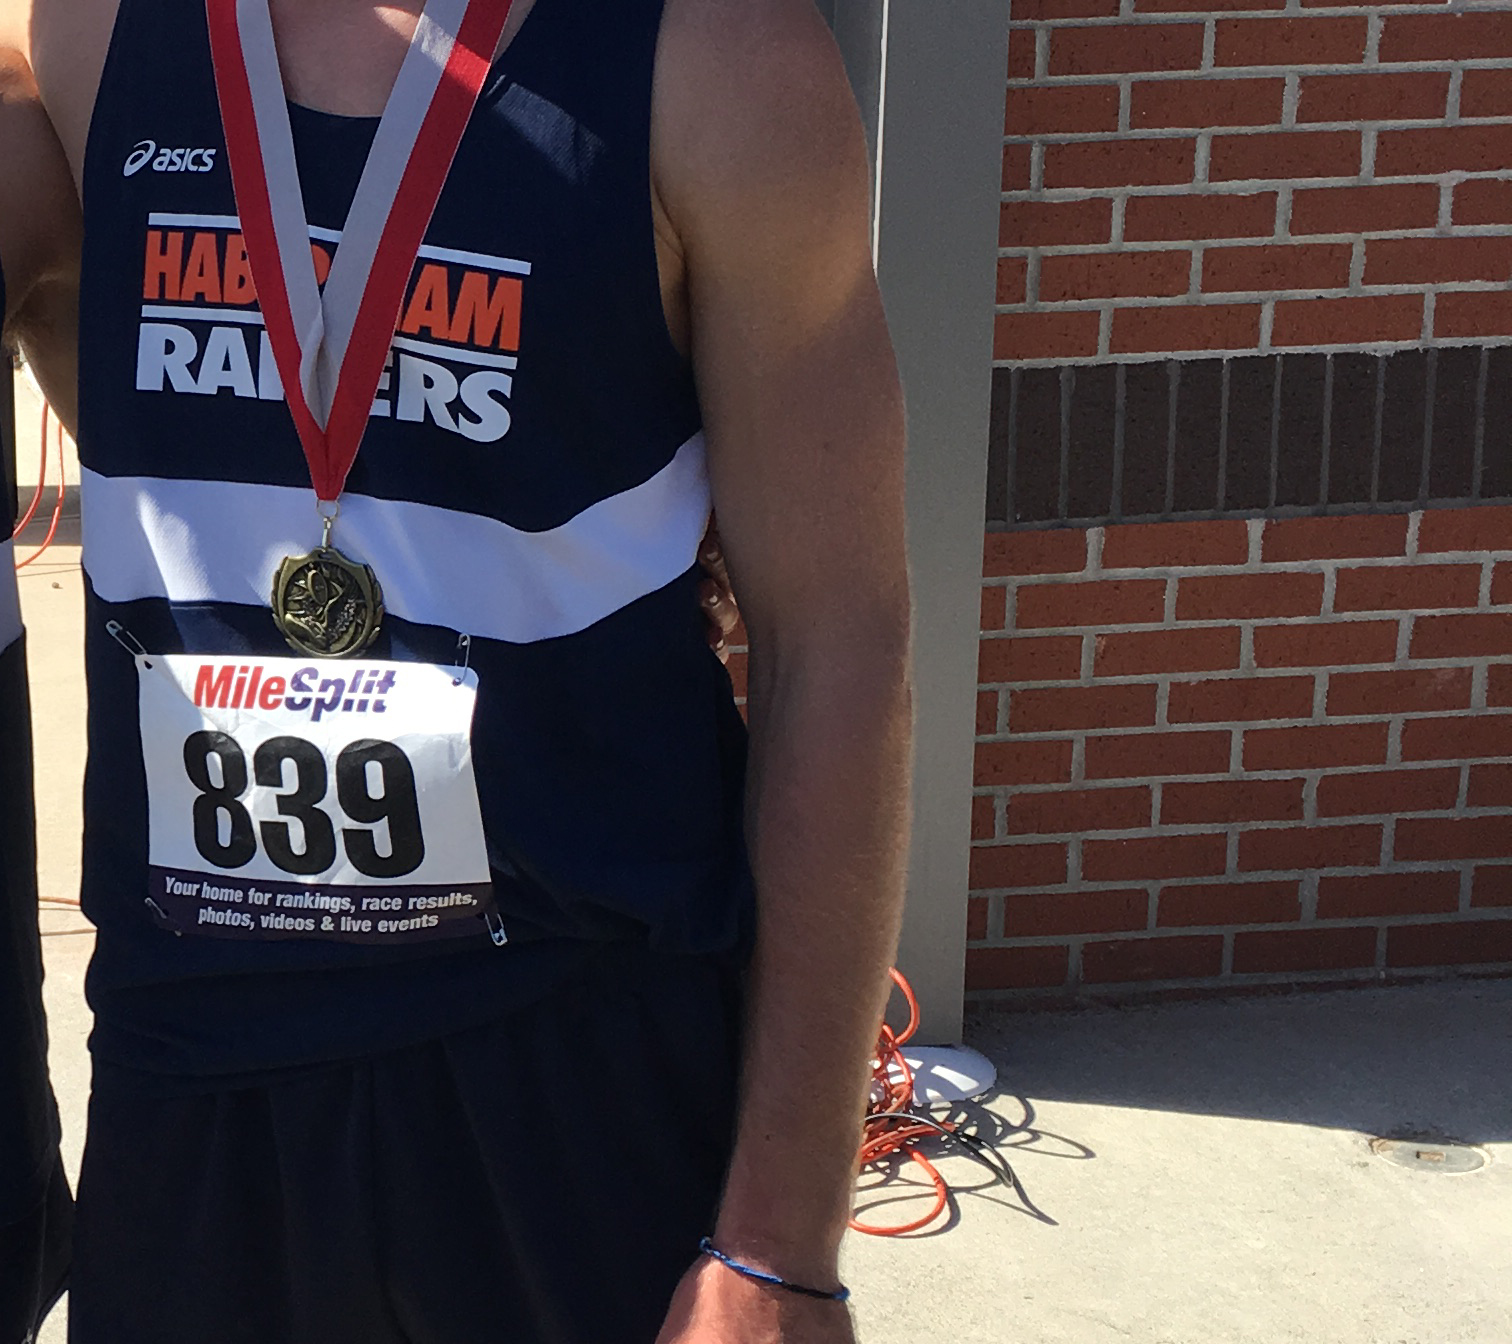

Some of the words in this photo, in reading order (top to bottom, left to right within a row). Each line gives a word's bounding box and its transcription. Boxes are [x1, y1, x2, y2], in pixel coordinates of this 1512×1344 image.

[153, 147, 216, 172] asics
[192, 664, 397, 722] MileSplit
[182, 729, 426, 879] 839
[164, 875, 201, 897] Your
[200, 880, 244, 905] home
[247, 887, 273, 907] for
[275, 891, 356, 915] rankings,
[360, 896, 403, 912] race
[407, 891, 479, 912] results,
[197, 905, 256, 932] photos,
[260, 912, 316, 932] videos
[320, 914, 335, 932] &
[340, 915, 373, 933] live
[377, 913, 440, 934] events
